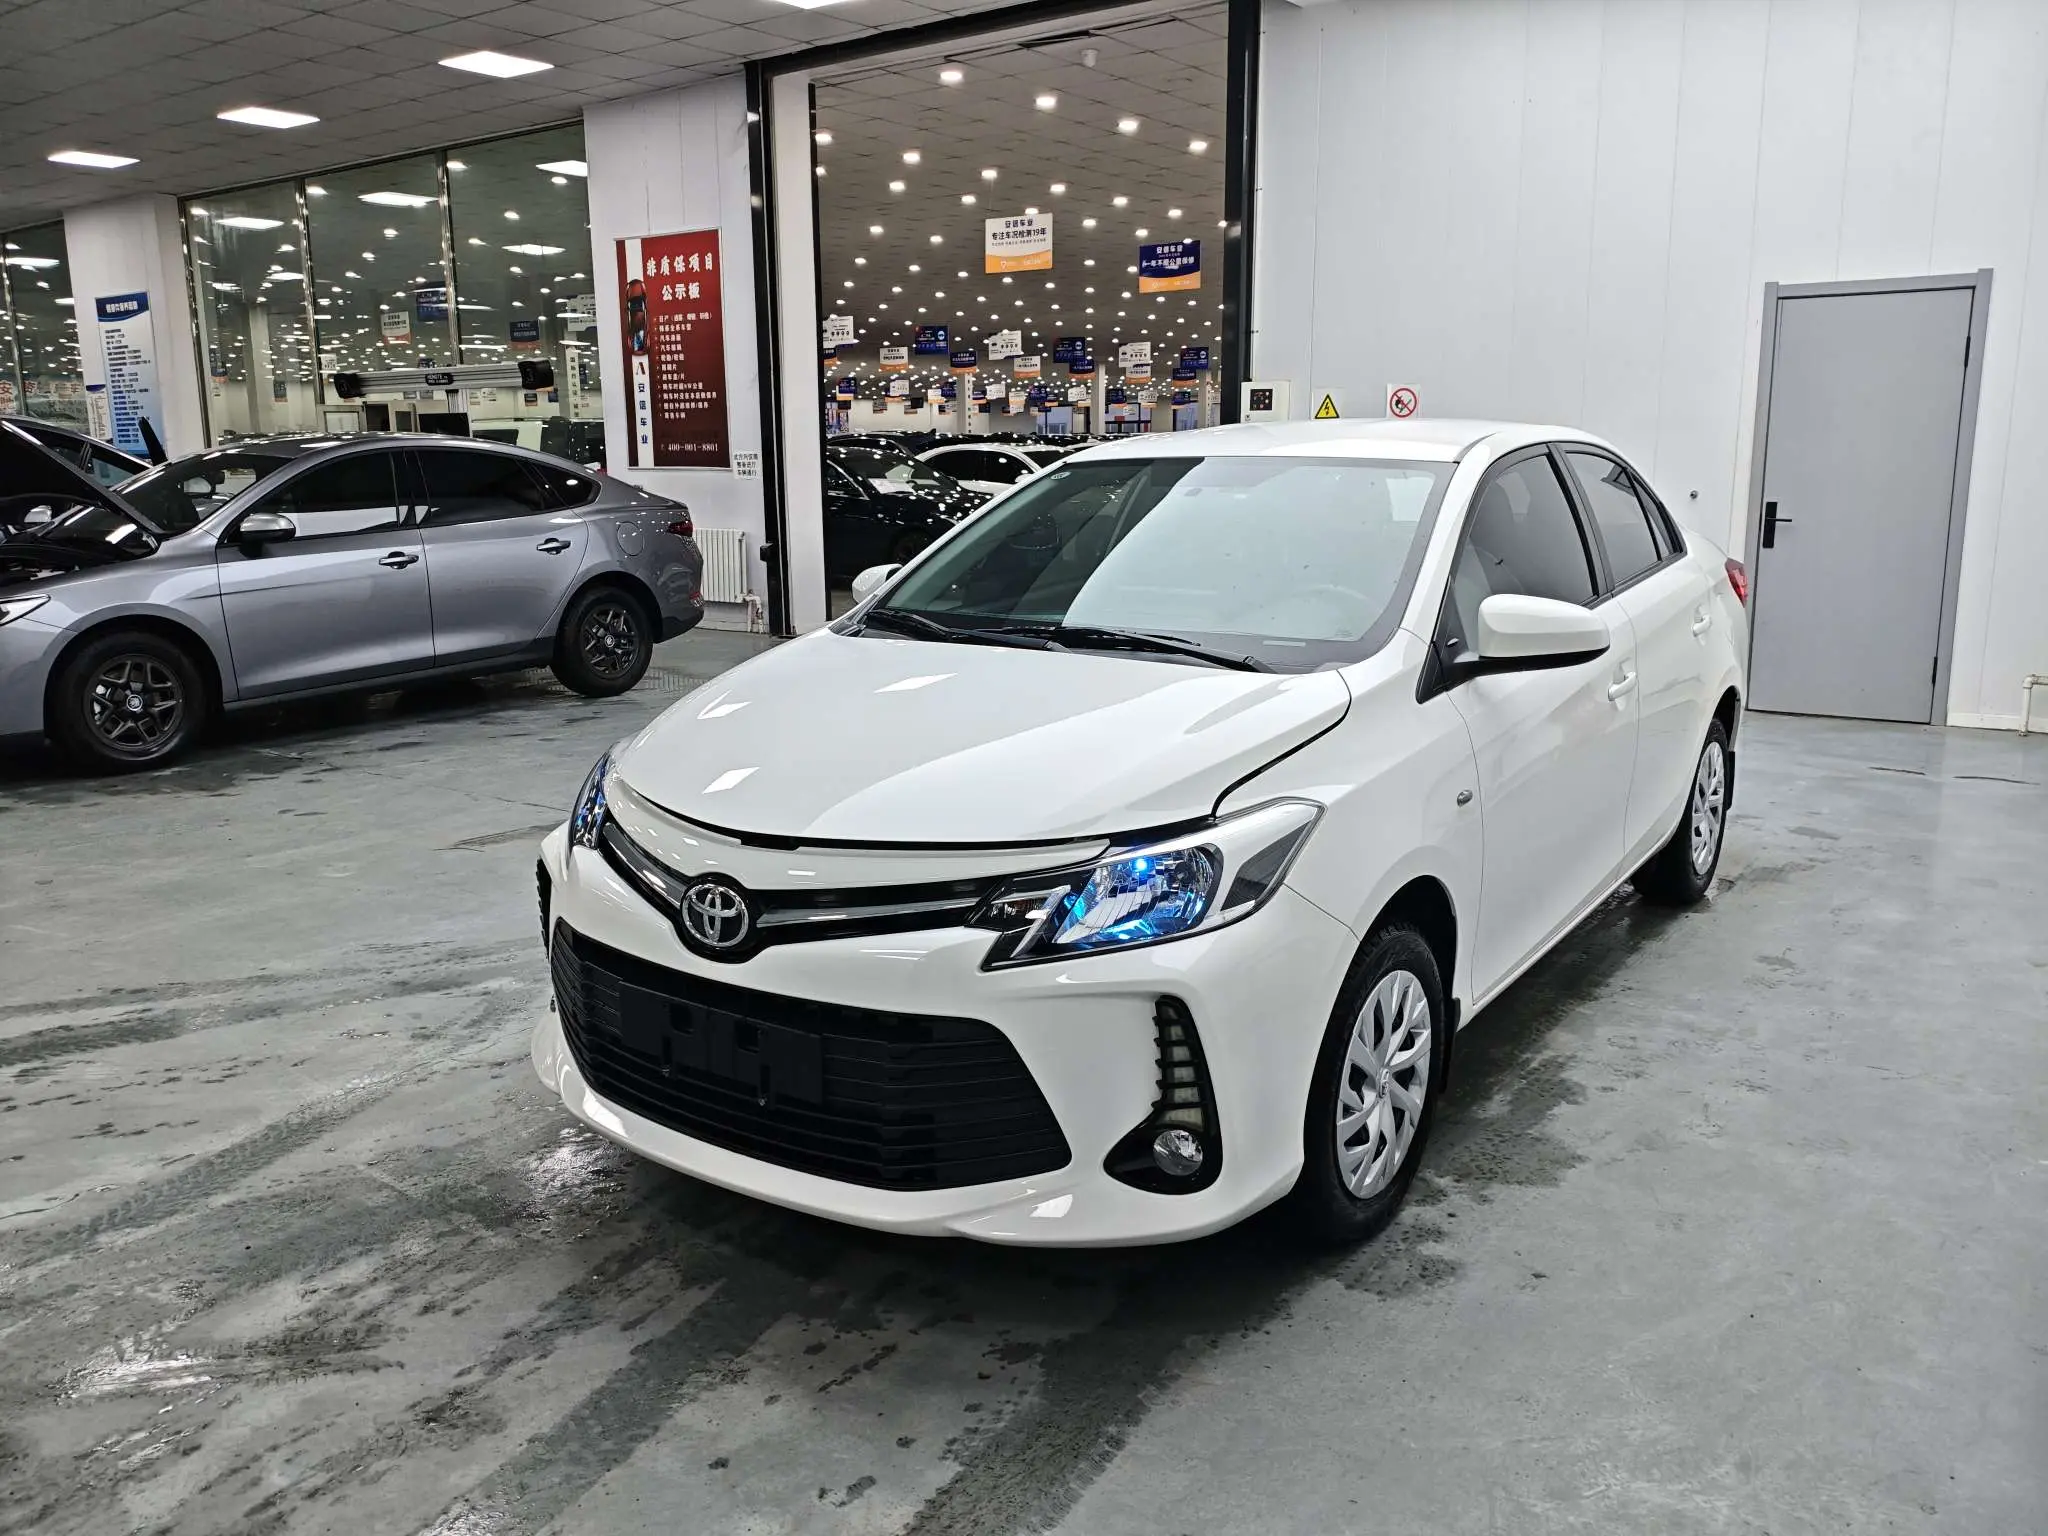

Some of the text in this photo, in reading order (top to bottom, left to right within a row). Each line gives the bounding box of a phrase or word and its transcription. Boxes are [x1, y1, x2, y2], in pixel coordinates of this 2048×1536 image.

[992, 227, 1047, 241] 专注车况检测19年
[646, 251, 713, 277] 非质保项目
[661, 281, 700, 301] 公示板
[637, 383, 649, 445] 安信车业
